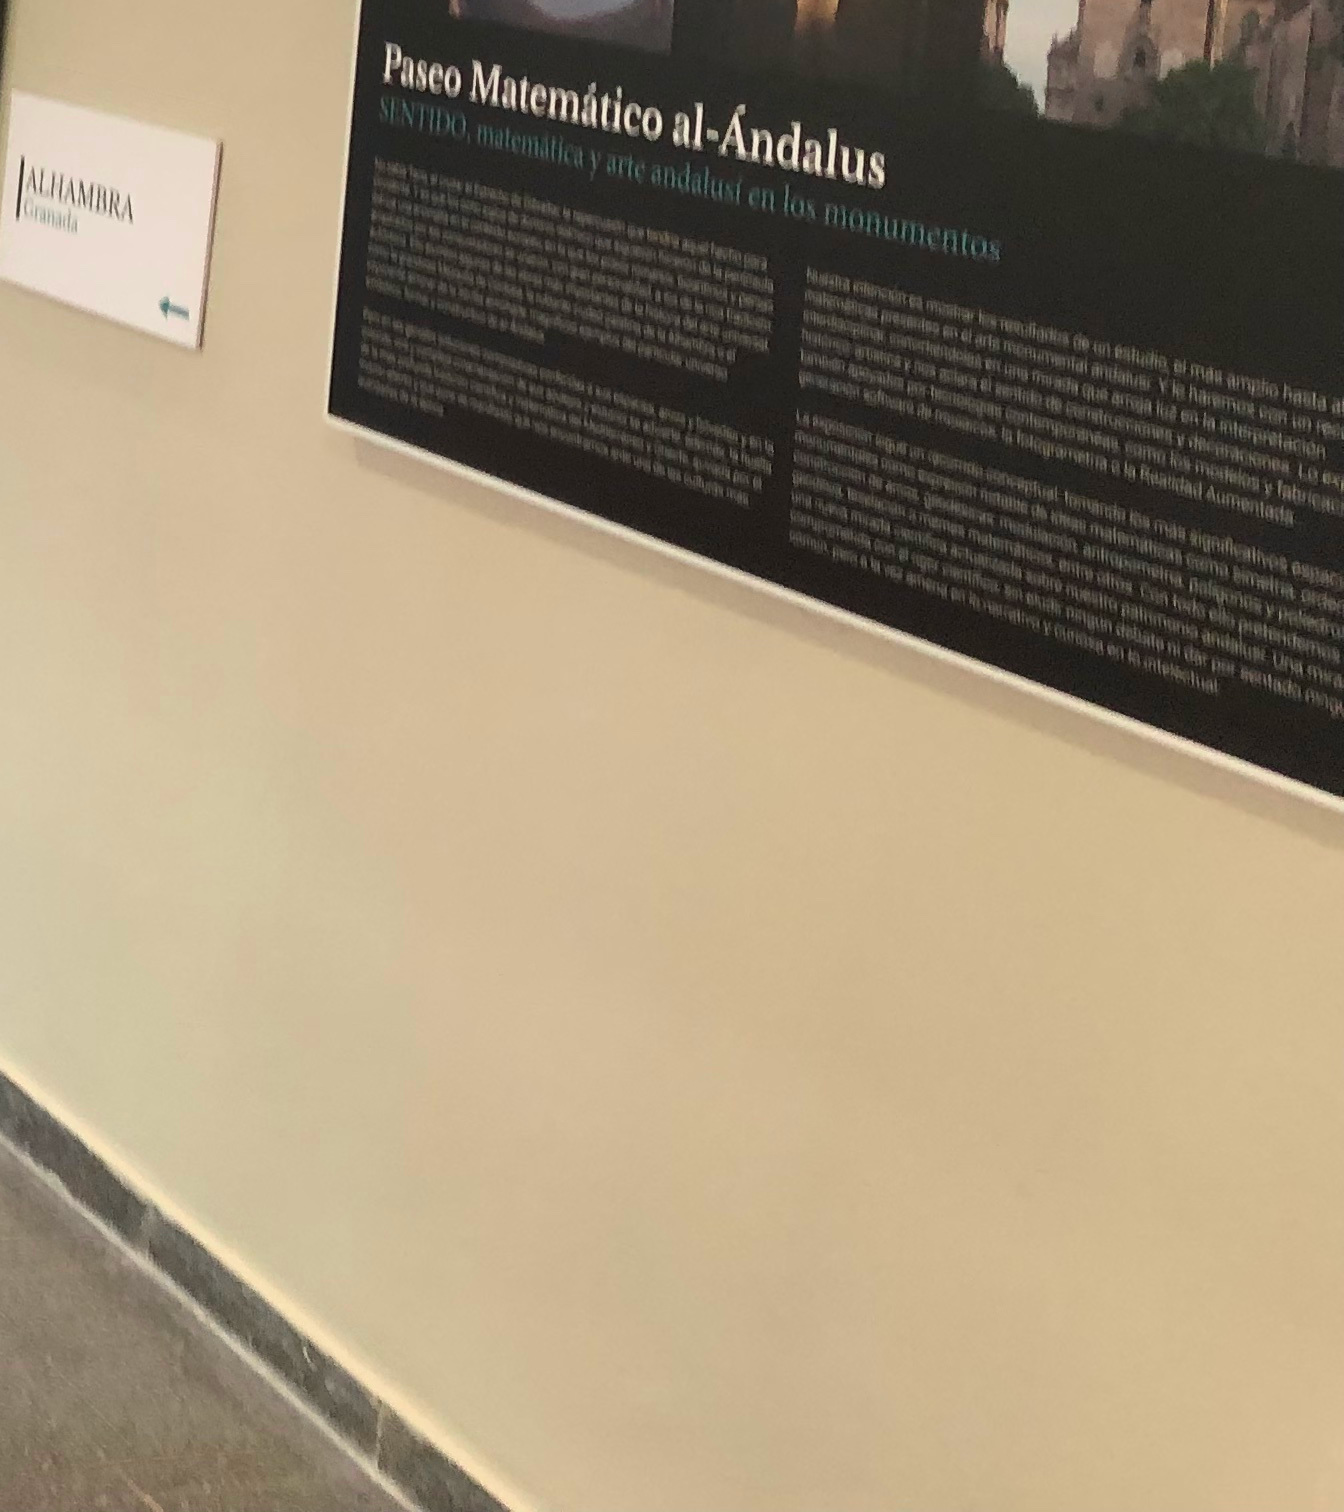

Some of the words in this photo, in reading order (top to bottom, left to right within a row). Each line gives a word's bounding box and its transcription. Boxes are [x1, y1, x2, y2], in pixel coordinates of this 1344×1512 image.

[382, 40, 462, 99] Paseo
[468, 58, 663, 143] Matemático
[672, 102, 886, 189] al-Ándalus
[24, 197, 78, 234] Granada
[26, 165, 134, 224] ALHAMBRA
[379, 95, 471, 144] SENTIDO,
[477, 124, 584, 170] matemática
[589, 149, 600, 182] y
[606, 153, 646, 185] arte
[651, 162, 742, 206] andalusí
[748, 187, 775, 214] en
[783, 182, 816, 219] los
[824, 201, 1002, 263] monumentos
